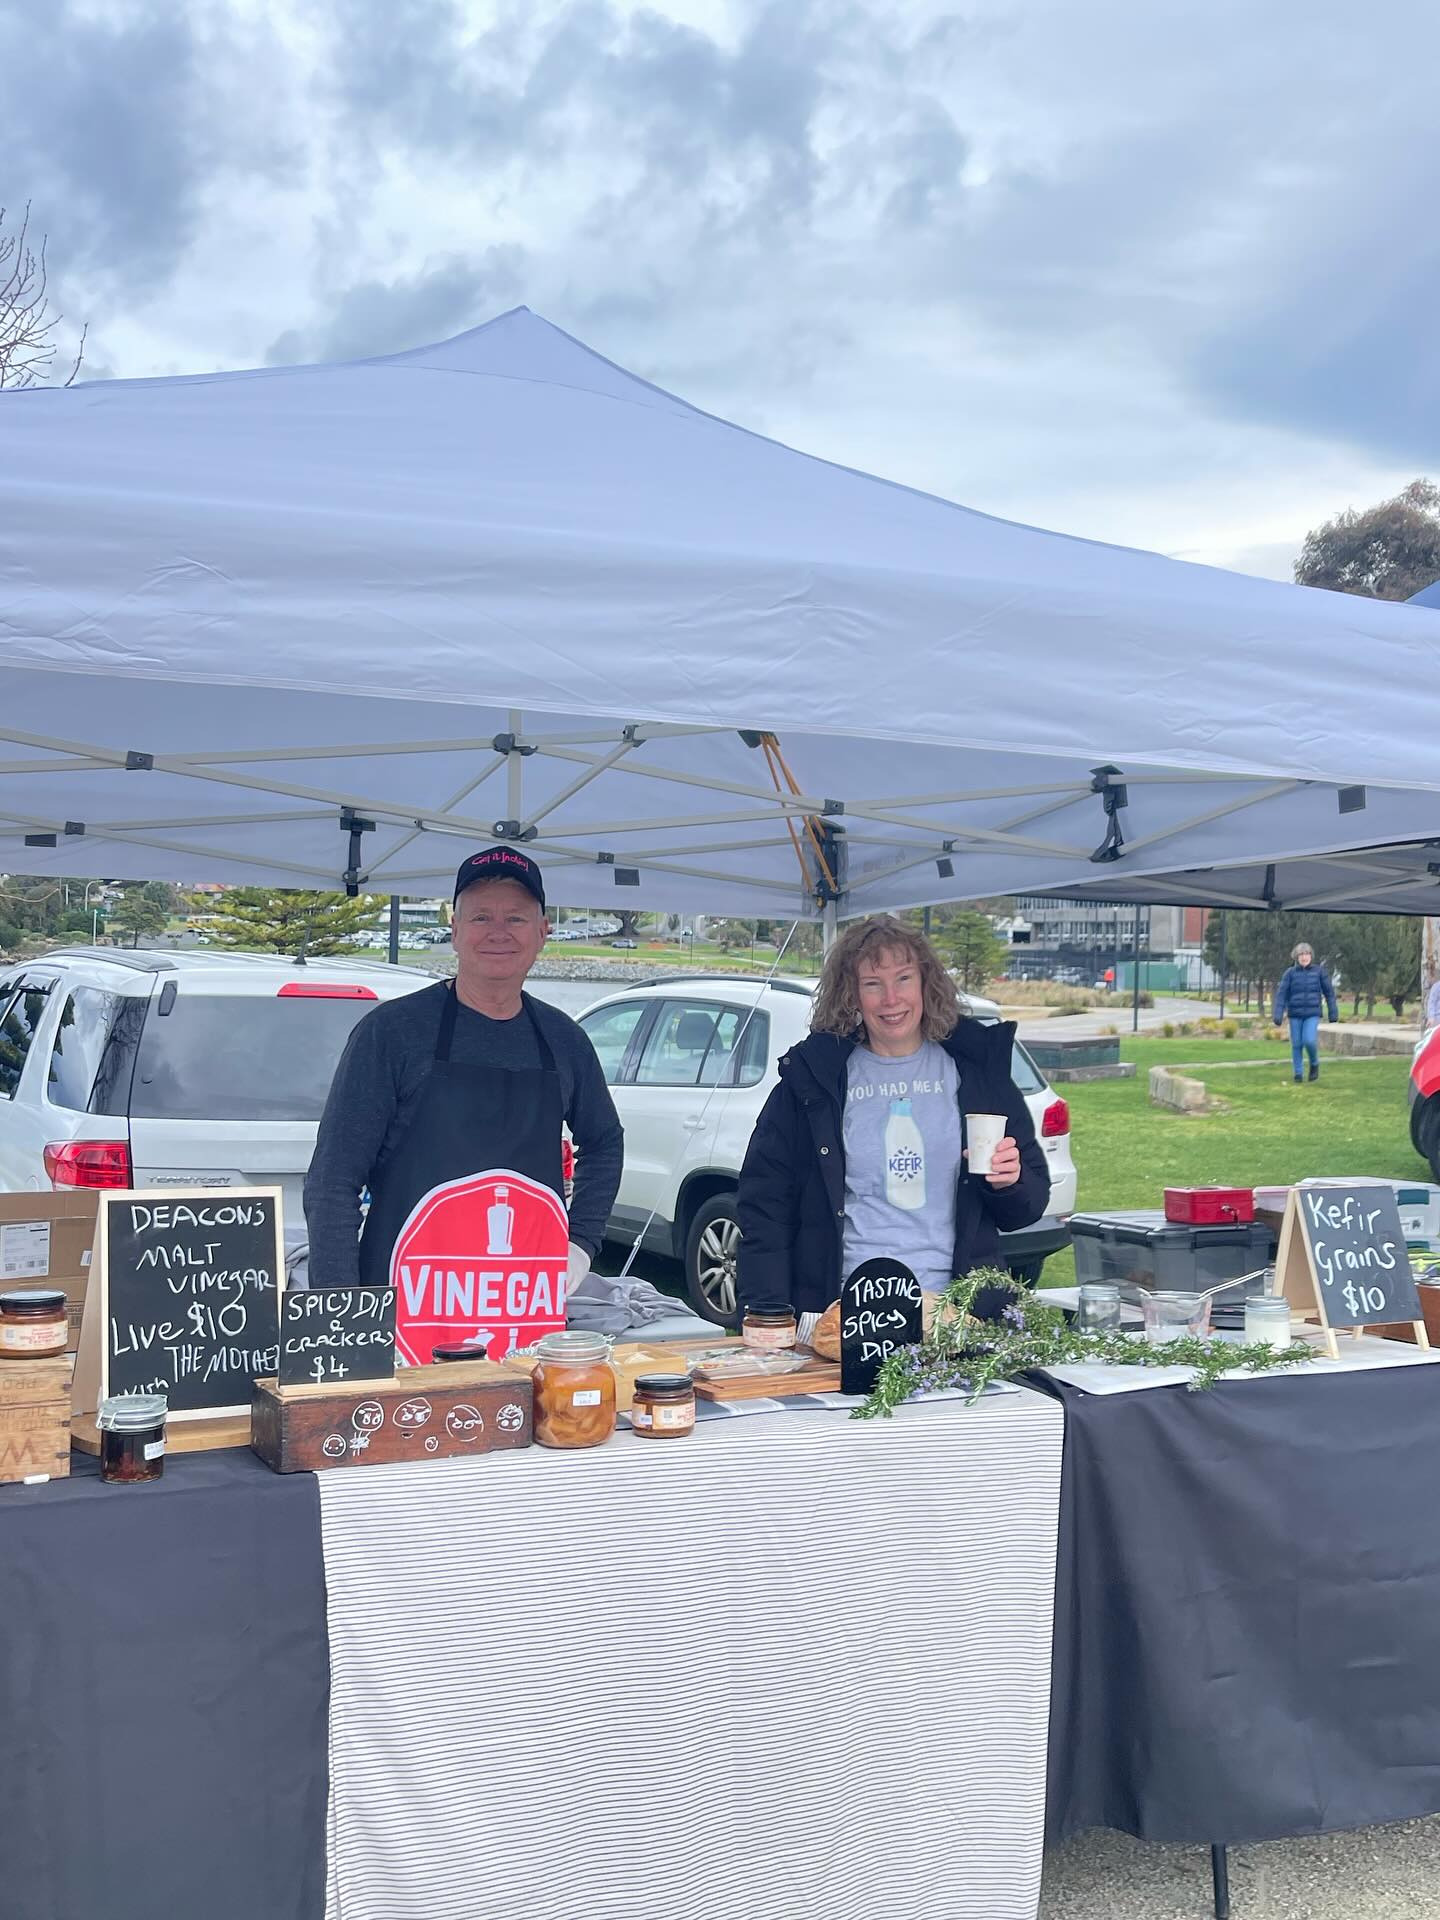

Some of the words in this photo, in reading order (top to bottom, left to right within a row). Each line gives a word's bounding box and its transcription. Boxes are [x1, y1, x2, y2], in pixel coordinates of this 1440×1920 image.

[847, 1084, 874, 1101] YOU
[879, 1081, 908, 1096] HAD
[912, 1079, 931, 1094] ME
[934, 1079, 944, 1094] A
[889, 1156, 923, 1171] KEFIR
[147, 1175, 231, 1185] TERRITORY
[1307, 1192, 1382, 1235] Kefir
[135, 1242, 222, 1271] MALT
[1314, 1240, 1396, 1286] Grains
[287, 1290, 353, 1321] SPICY
[351, 1290, 394, 1322] DIP
[849, 1276, 923, 1308] TASTING
[1341, 1279, 1386, 1317] $10
[187, 1300, 247, 1341] $10
[842, 1308, 908, 1339] SPICY
[163, 1343, 206, 1384] THE
[309, 1355, 350, 1384] $4
